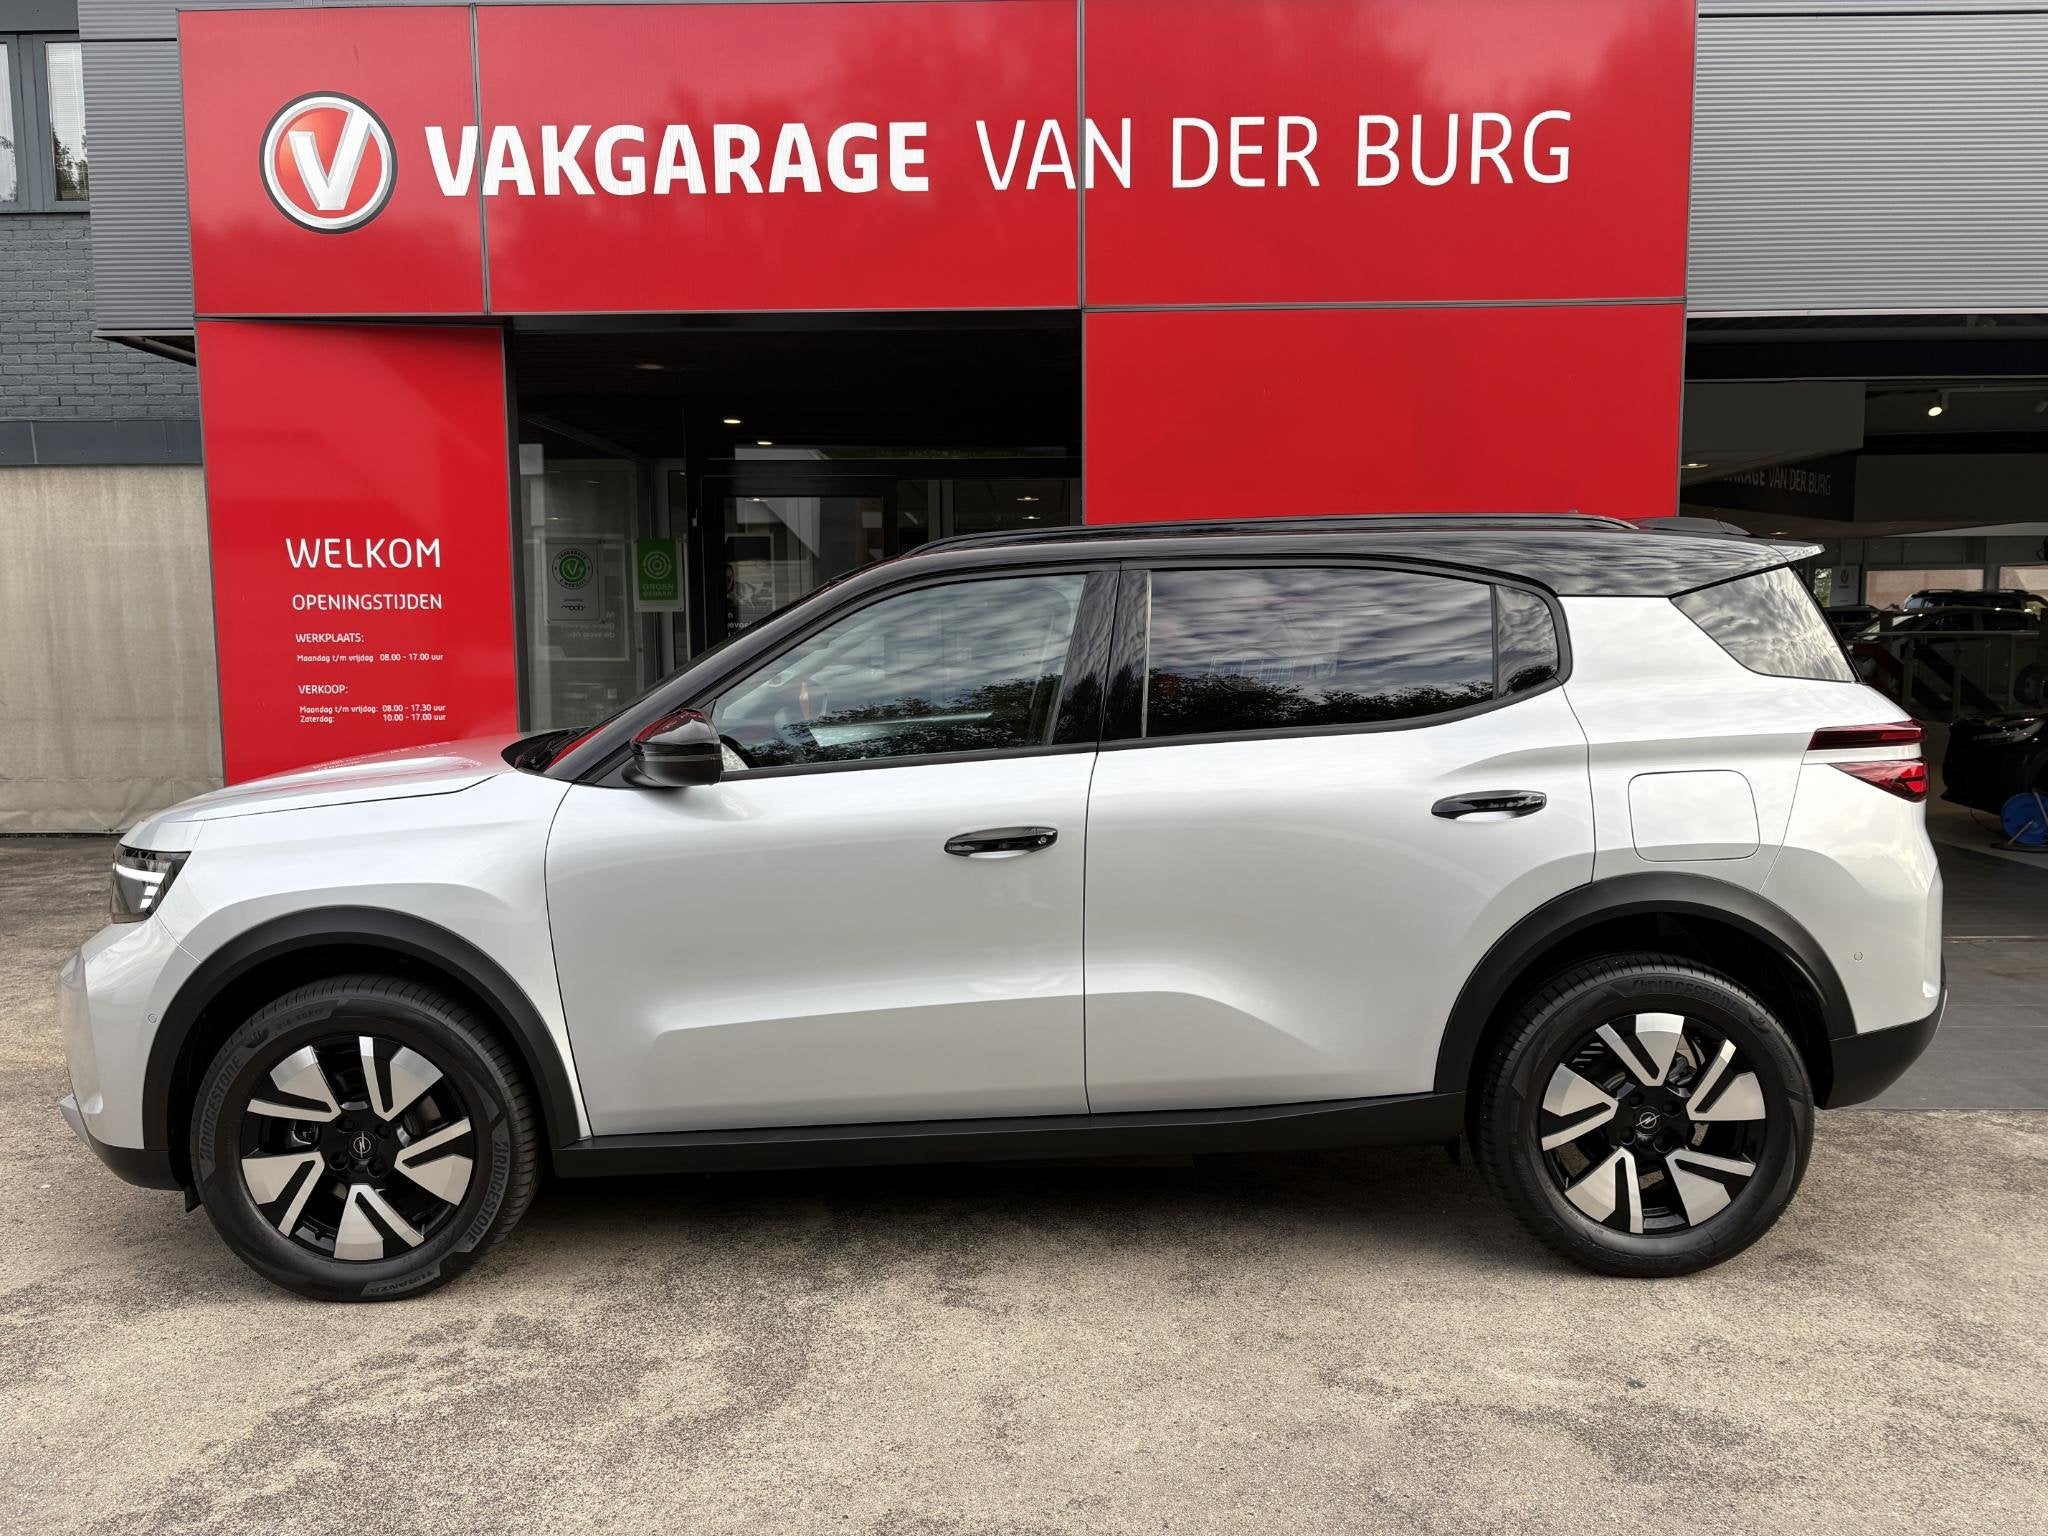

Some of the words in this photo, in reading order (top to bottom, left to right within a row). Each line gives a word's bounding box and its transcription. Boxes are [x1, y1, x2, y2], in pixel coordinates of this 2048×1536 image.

[424, 121, 930, 197] VAKGARAGE
[975, 116, 1132, 191] VAN
[1171, 115, 1321, 189] DER
[1356, 109, 1572, 188] BURG
[1768, 466, 1788, 489] VAN
[1789, 469, 1807, 492] DER
[1808, 471, 1832, 496] BURG
[285, 537, 442, 569] WELKOM
[292, 593, 442, 611] OPENINGSTIJDEN
[295, 633, 364, 643] WERKPLAATS:
[297, 654, 330, 663] Maandag
[332, 654, 347, 662] t/m
[348, 653, 374, 663] vrijdag
[379, 653, 401, 662] 08.00
[409, 653, 430, 661] 17.00
[298, 684, 349, 694] VERKOOP:
[299, 705, 333, 714] Maandag
[334, 705, 350, 713] t/m
[382, 704, 404, 712] 08.00
[411, 703, 432, 712] 17.30
[300, 715, 335, 724] Zaterdag:
[383, 713, 404, 721] 10.00
[411, 713, 432, 721] 17.00
